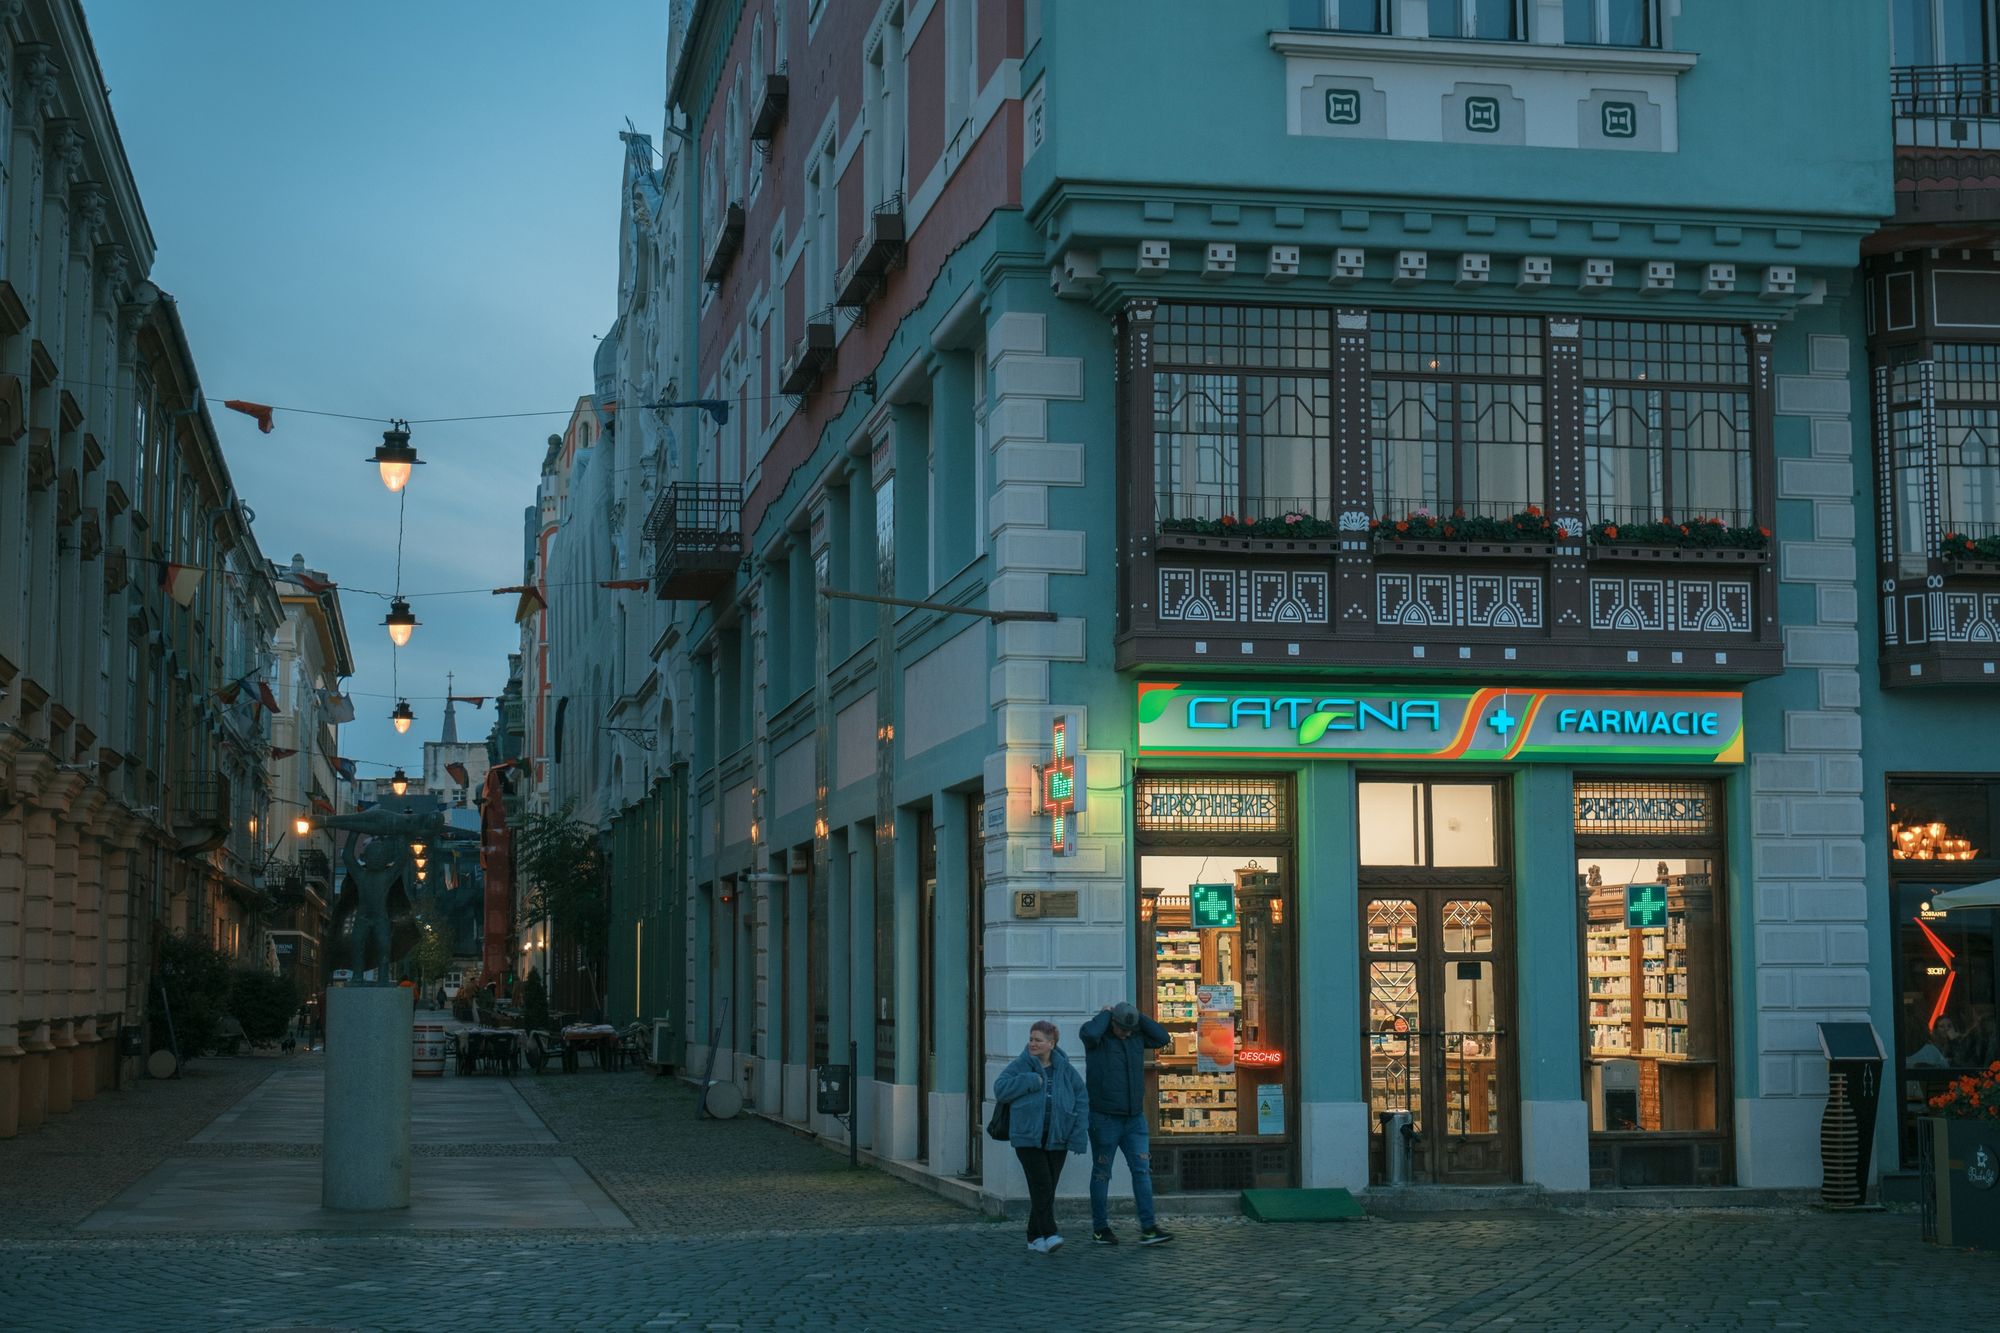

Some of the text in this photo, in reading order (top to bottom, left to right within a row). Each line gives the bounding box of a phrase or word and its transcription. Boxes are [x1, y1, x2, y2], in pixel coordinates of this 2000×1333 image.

[1187, 697, 1719, 736] CATENA FARMACIE
[1151, 794, 1271, 817] APOTHEKE
[1580, 798, 1705, 820] PHARMACIE
[1240, 1051, 1281, 1063] DESCHIS
